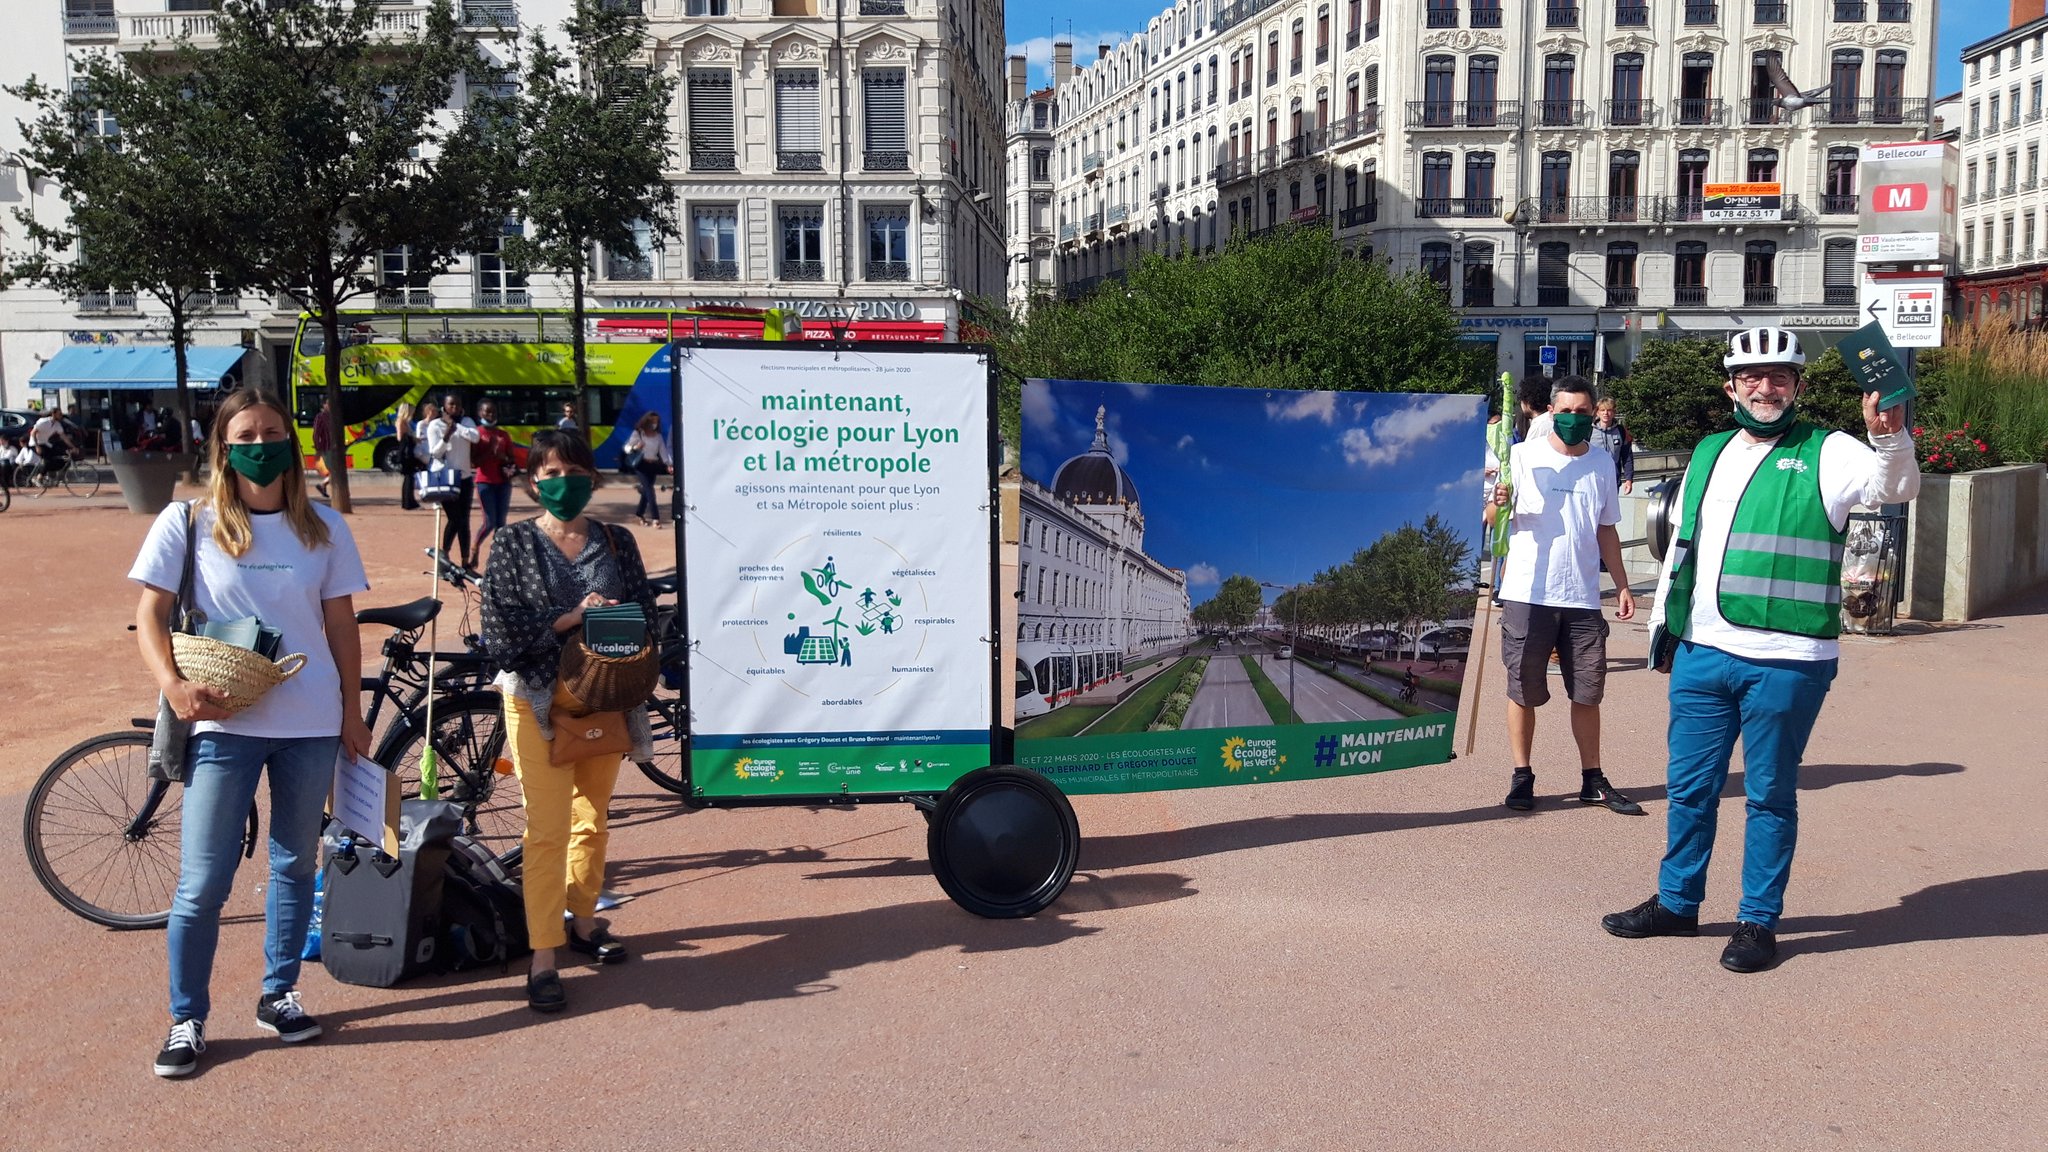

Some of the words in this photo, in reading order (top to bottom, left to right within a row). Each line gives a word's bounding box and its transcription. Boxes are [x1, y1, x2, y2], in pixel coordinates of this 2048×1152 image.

[1877, 149, 1928, 159] Bellecour
[1888, 187, 1912, 208] M
[1709, 210, 1721, 218] 04
[1723, 210, 1734, 218] 78
[1763, 209, 1774, 217] 17
[774, 301, 846, 318] PIZZA
[857, 300, 916, 319] PINO
[1486, 318, 1548, 328] VOYAGES
[804, 331, 831, 339] PIZZA
[343, 359, 412, 378] CITYBUS
[884, 366, 895, 374] juin
[761, 389, 912, 416] maintenant,
[713, 418, 829, 448] l'écologie
[837, 426, 895, 448] pour
[903, 422, 959, 449] Lyon
[743, 453, 767, 471] et
[776, 450, 796, 471] la
[804, 449, 932, 478] métropole
[735, 482, 786, 496] agissons
[789, 483, 855, 494] maintenant
[858, 485, 886, 497] pour
[889, 486, 911, 497] que
[913, 484, 940, 497] Lyon
[756, 500, 768, 510] et
[771, 501, 784, 510] sa
[787, 499, 848, 513] Métropole
[851, 500, 886, 511] soient
[889, 500, 914, 513] plus
[823, 529, 862, 538] résilientes
[248, 562, 293, 571] écologistes
[738, 564, 769, 573] proches
[771, 564, 784, 572] des
[891, 568, 936, 578] végétalisées
[722, 618, 768, 627] protectrices
[914, 617, 955, 626] respirables
[592, 642, 640, 654] l'écologie
[746, 667, 786, 676] équitables
[891, 665, 934, 673] humanistes
[1341, 723, 1446, 748] MAINTENANT
[797, 737, 820, 745] Grégory
[1246, 738, 1277, 748] europe
[1021, 757, 1029, 765] 15
[1030, 756, 1041, 764] ET
[1043, 755, 1052, 763] 22
[1054, 754, 1077, 762] MARS
[1079, 753, 1099, 761] 2020
[1106, 751, 1120, 759] LES
[1176, 746, 1196, 755] AVEC
[1234, 745, 1277, 759] écologie
[1243, 758, 1254, 767] les
[1255, 756, 1277, 766] Verts
[1339, 750, 1382, 766] LYON
[744, 763, 776, 771] écologie
[1057, 763, 1101, 774] BERNARD
[1103, 763, 1114, 771] ET
[1162, 757, 1197, 766] DOUCET
[1068, 773, 1119, 784] MUNICIPALES
[1120, 773, 1129, 781] ET
